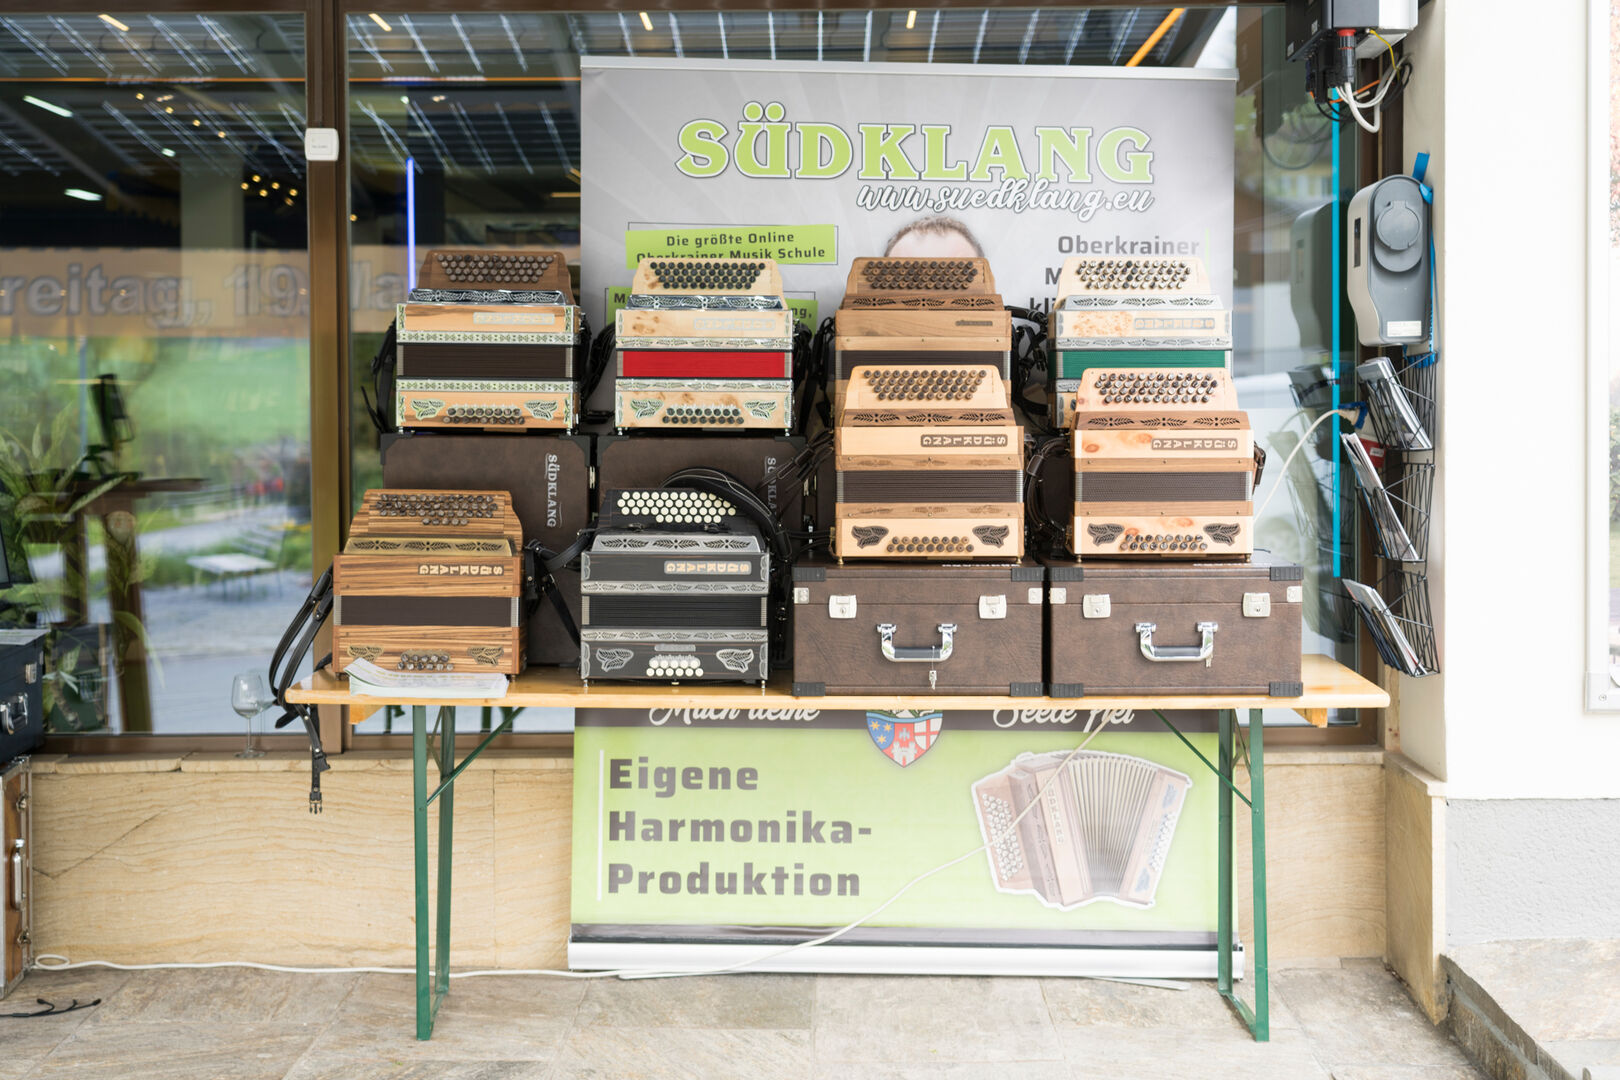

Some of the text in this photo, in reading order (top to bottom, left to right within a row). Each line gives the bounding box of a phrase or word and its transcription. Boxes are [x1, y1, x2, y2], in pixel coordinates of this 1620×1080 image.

[675, 101, 1155, 183] SÜDKLANG
[856, 177, 1155, 222] www.suedklang.eu
[667, 233, 794, 249] Die größte Online
[730, 248, 772, 258] Musik
[778, 247, 825, 258] Schule
[1058, 235, 1200, 255] Oberkrainer
[0, 262, 214, 328] reitag,
[547, 454, 561, 527] SÜDKLANG
[609, 756, 758, 799] Eigene
[609, 810, 872, 844] Harmonika-
[608, 861, 860, 896] Produktion
